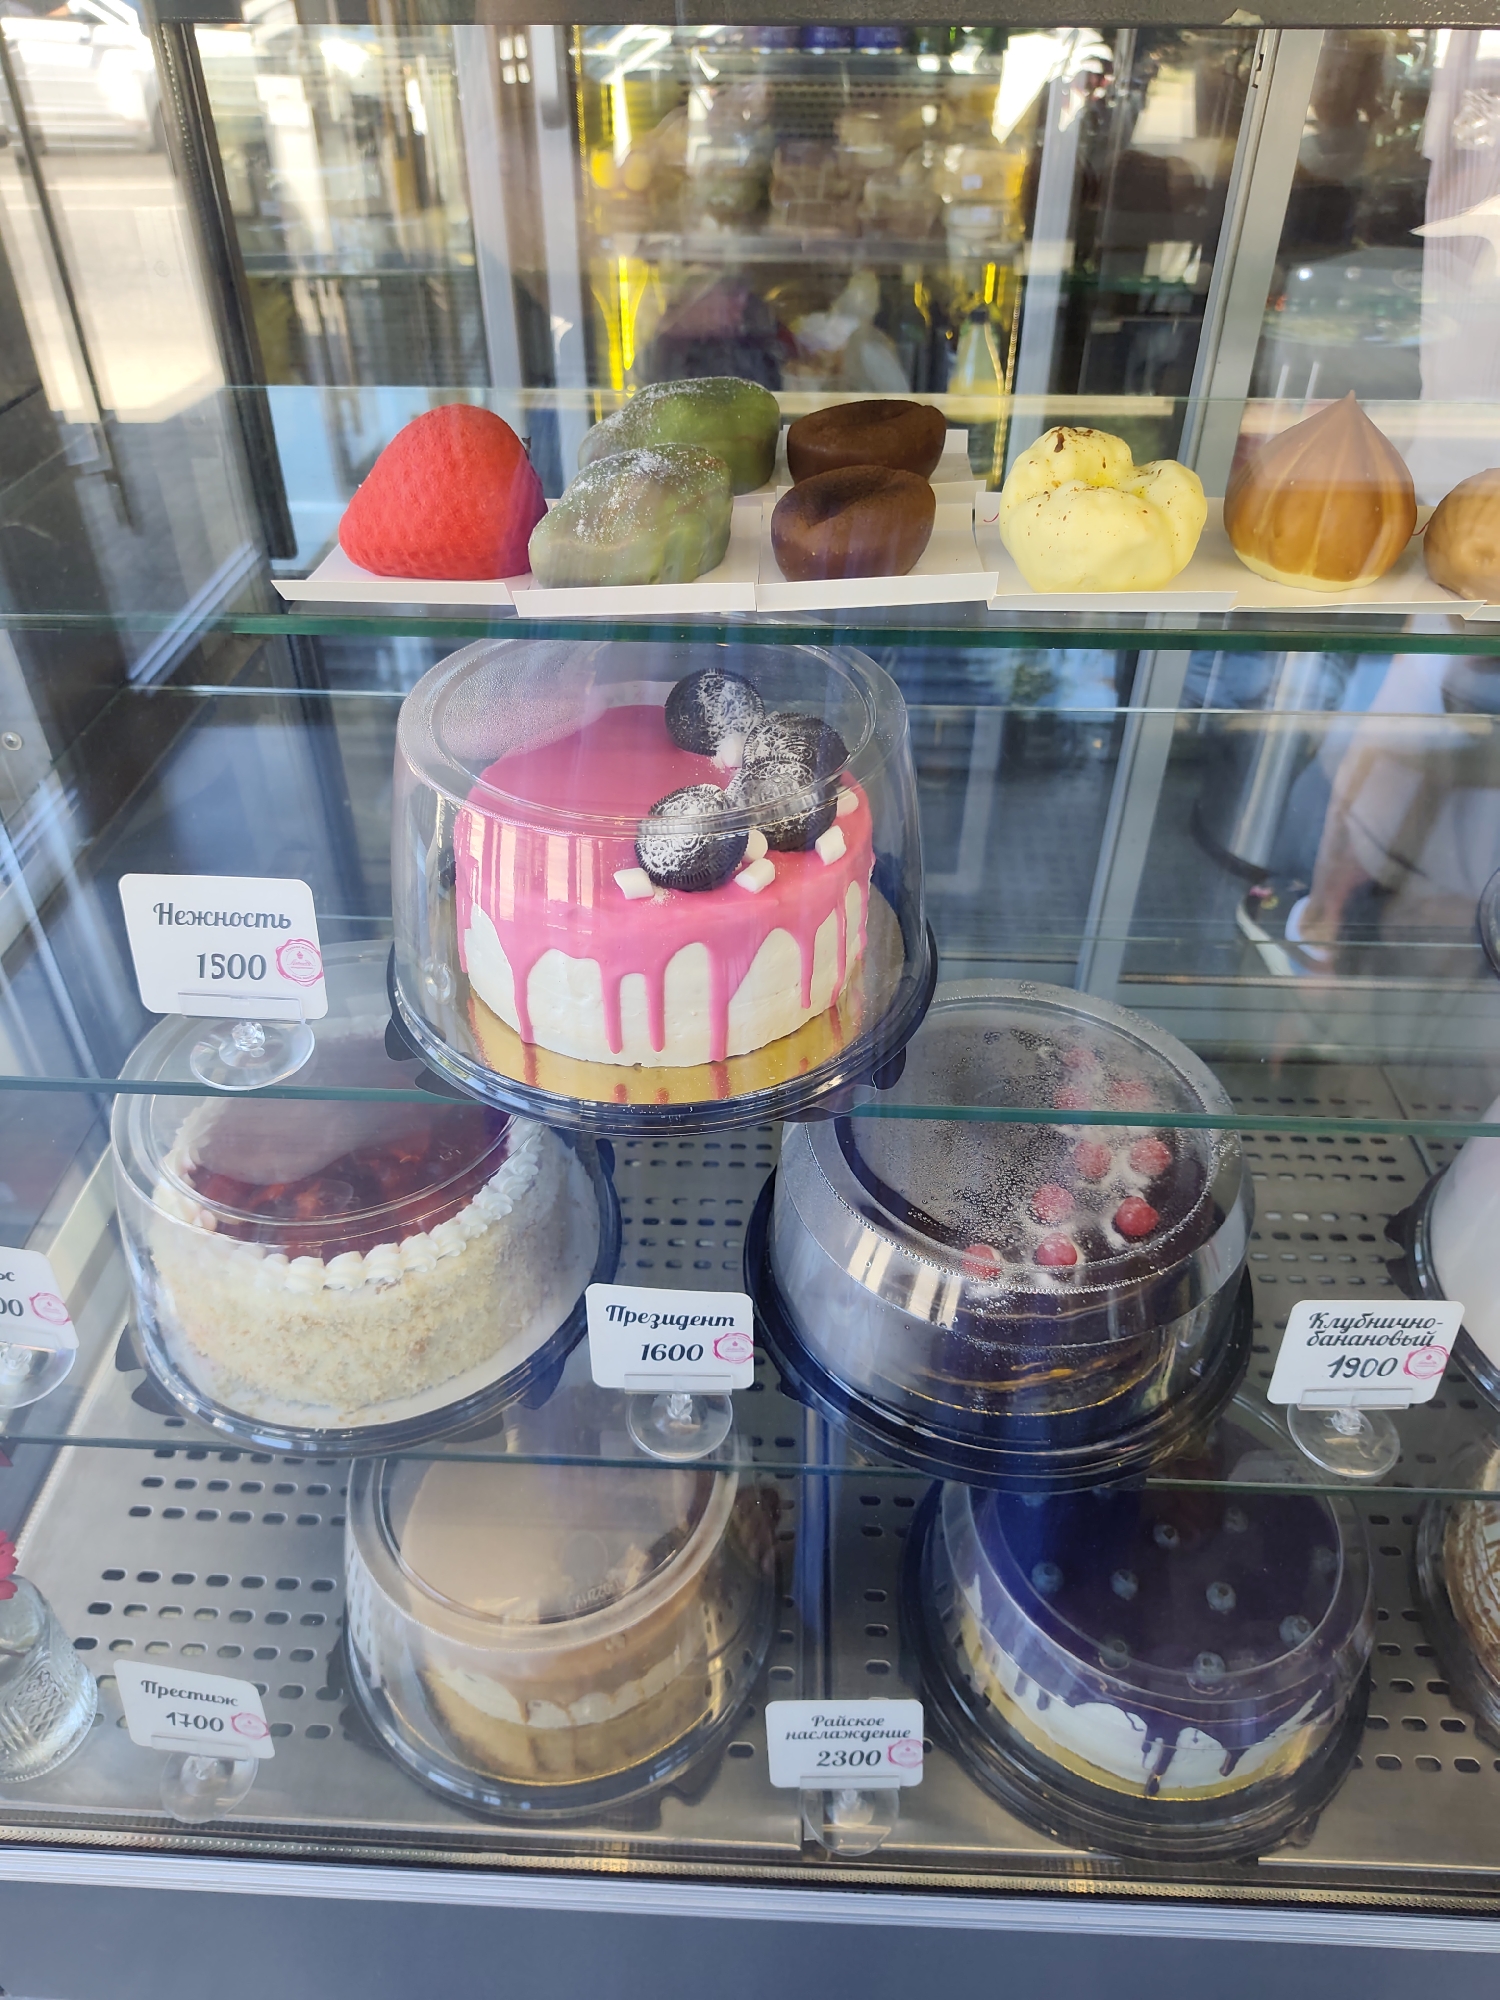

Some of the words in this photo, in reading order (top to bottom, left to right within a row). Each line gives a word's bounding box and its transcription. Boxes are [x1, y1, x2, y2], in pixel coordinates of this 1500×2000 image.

[153, 902, 292, 930] Нежность
[197, 953, 268, 981] 1500
[605, 1304, 736, 1331] Президент
[1309, 1311, 1444, 1333] Клубнично-
[1306, 1330, 1438, 1347] банановый
[641, 1343, 704, 1362] 1600
[1327, 1354, 1399, 1379] 1900
[141, 1680, 239, 1707] Престиж
[166, 1711, 225, 1732] 1700
[811, 1714, 885, 1728] Райское
[785, 1729, 911, 1743] наслаждение
[816, 1750, 882, 1767] 2300
